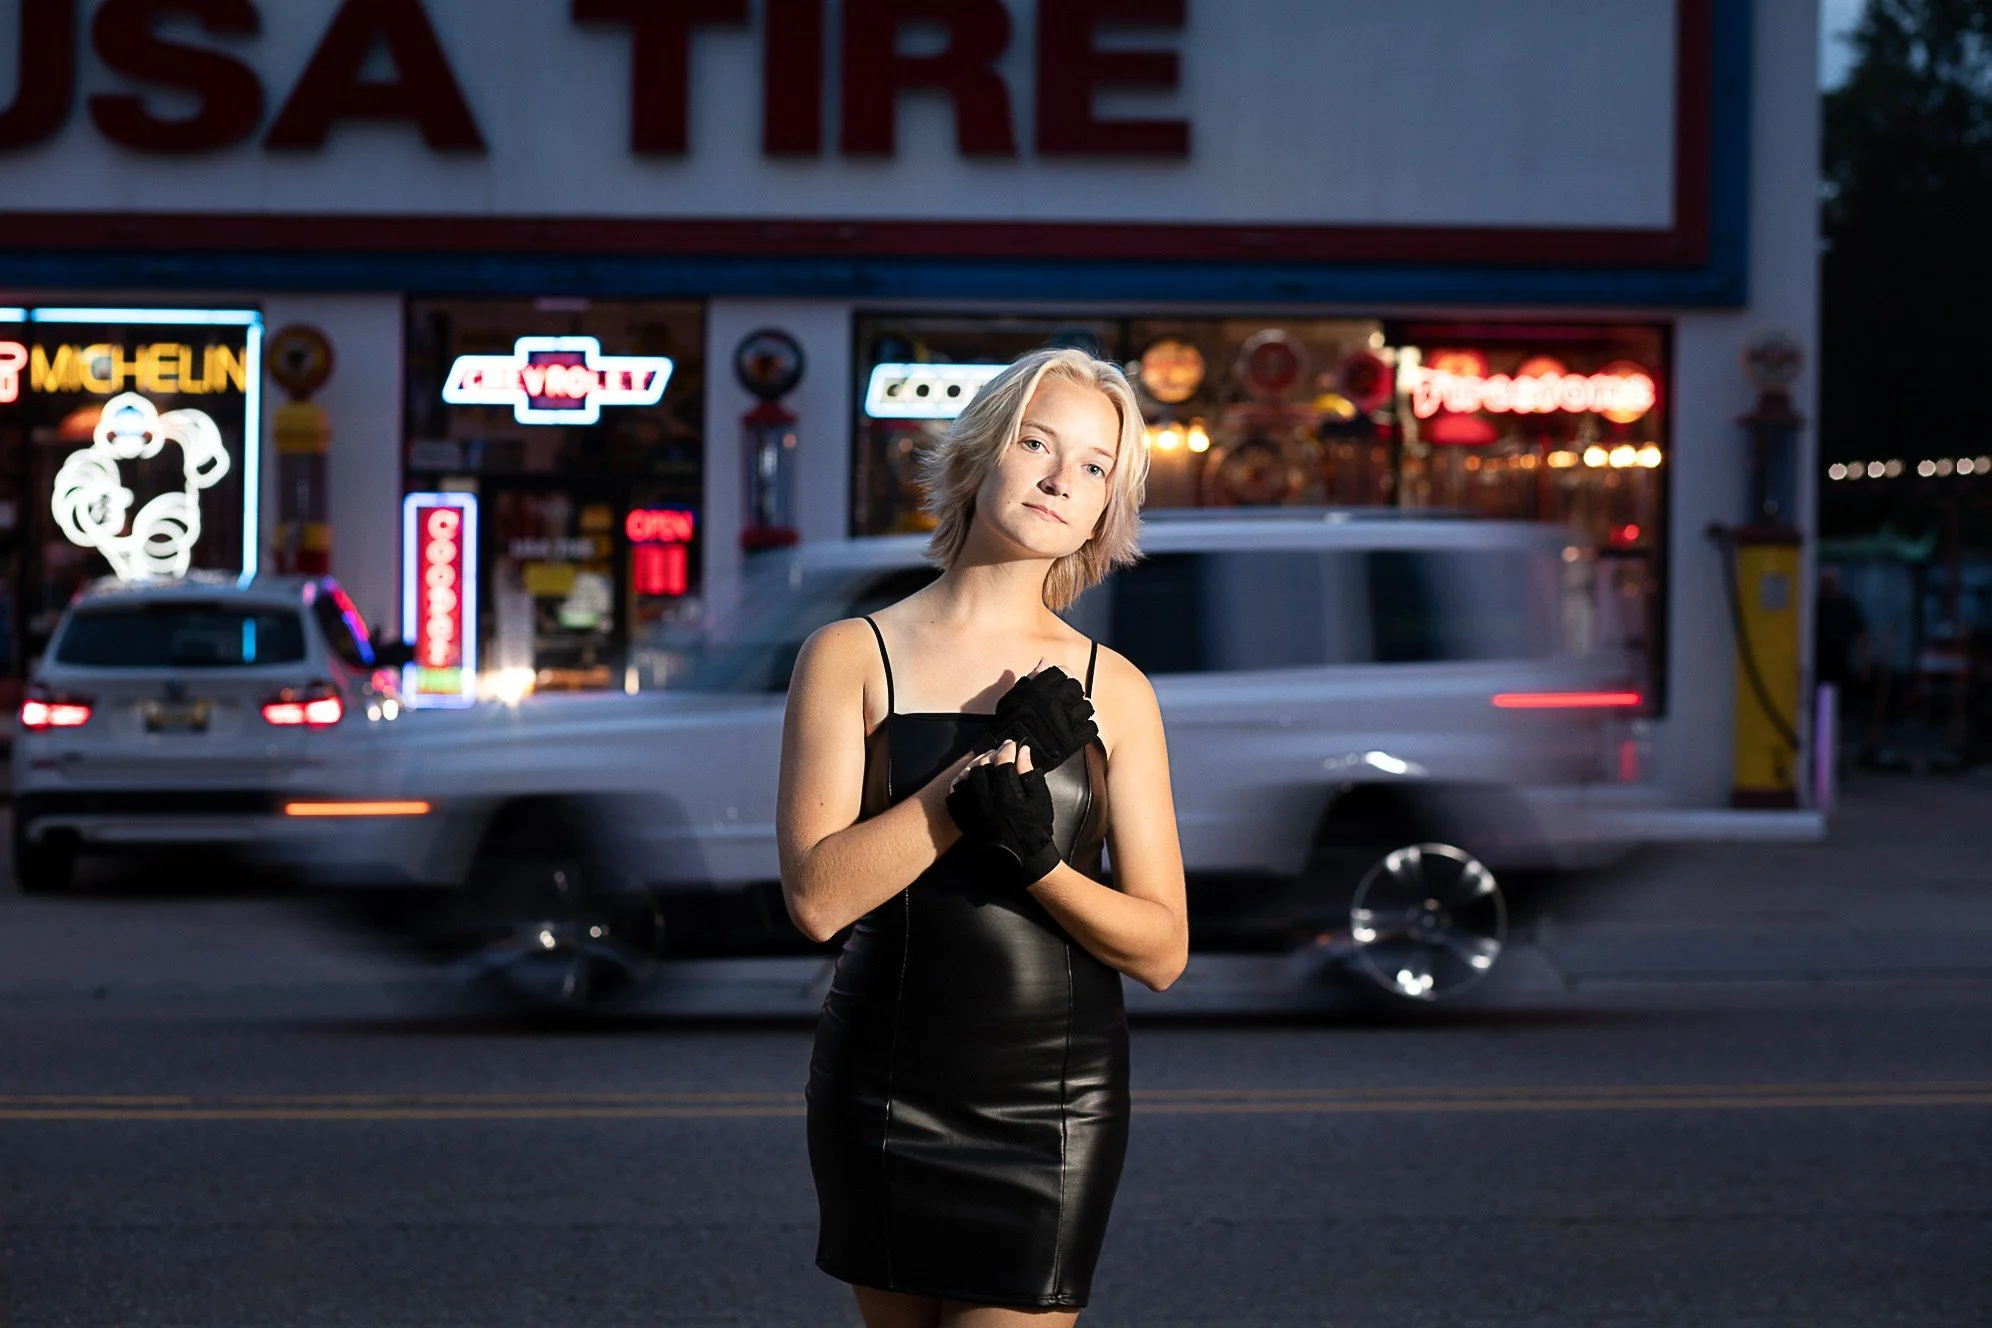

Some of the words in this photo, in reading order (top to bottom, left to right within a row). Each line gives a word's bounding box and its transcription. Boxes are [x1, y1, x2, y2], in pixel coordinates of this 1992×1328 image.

[572, 0, 1192, 159] TIRE
[31, 343, 248, 393] MICHELIN
[461, 363, 654, 399] CHEVROLET
[625, 509, 693, 542] OPEN
